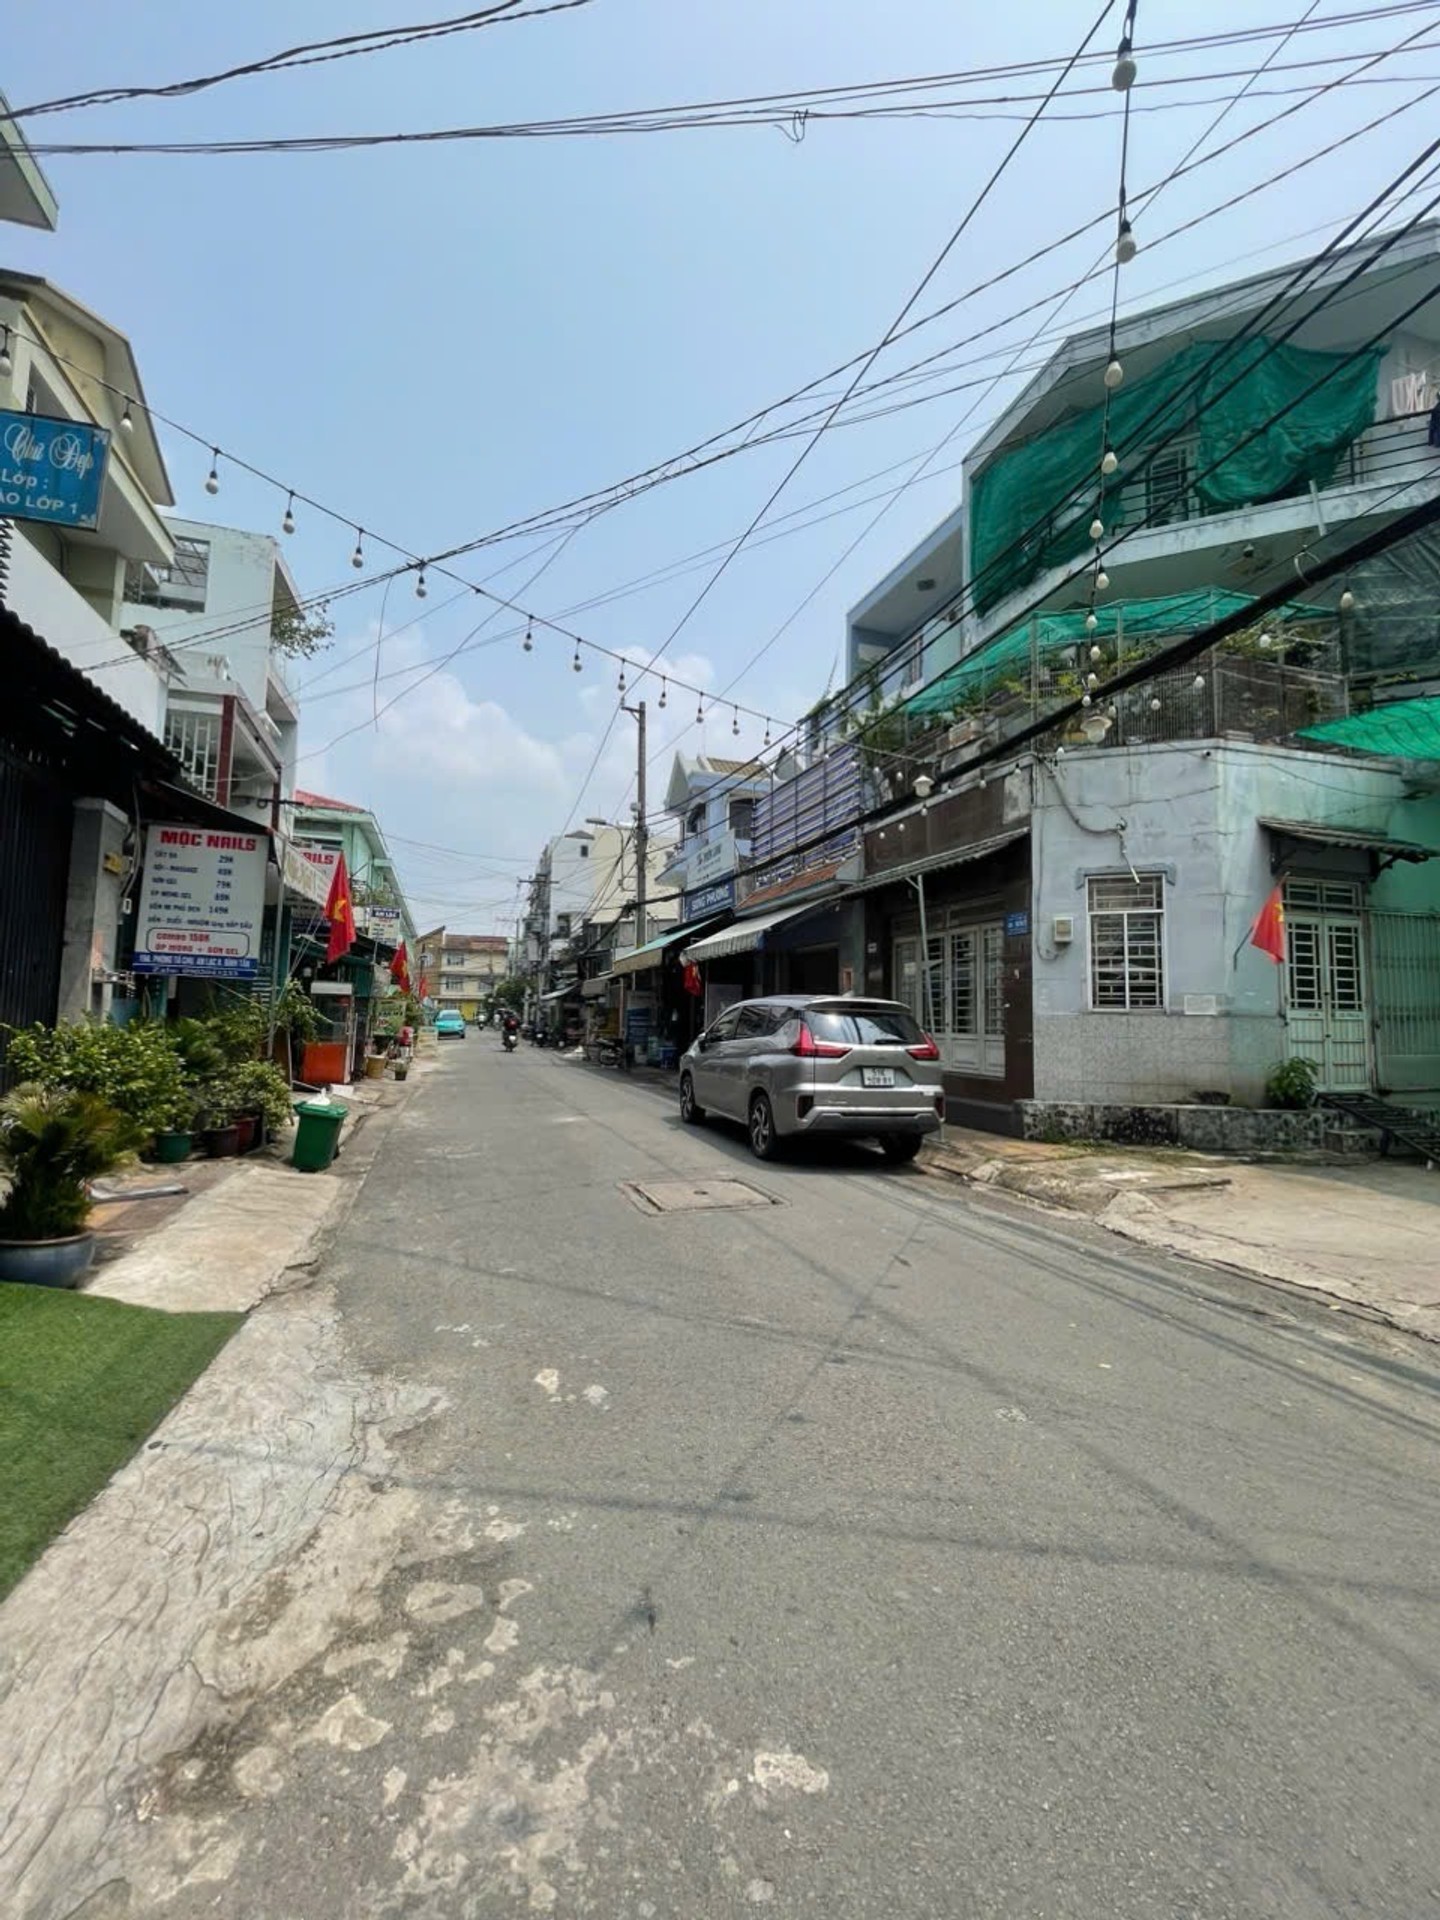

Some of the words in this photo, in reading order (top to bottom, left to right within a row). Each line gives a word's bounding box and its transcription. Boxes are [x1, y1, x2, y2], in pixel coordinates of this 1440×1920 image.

[25, 494, 64, 511] LỚP
[70, 502, 78, 514] 1
[160, 829, 202, 849] MỘC
[207, 834, 256, 851] NAILS
